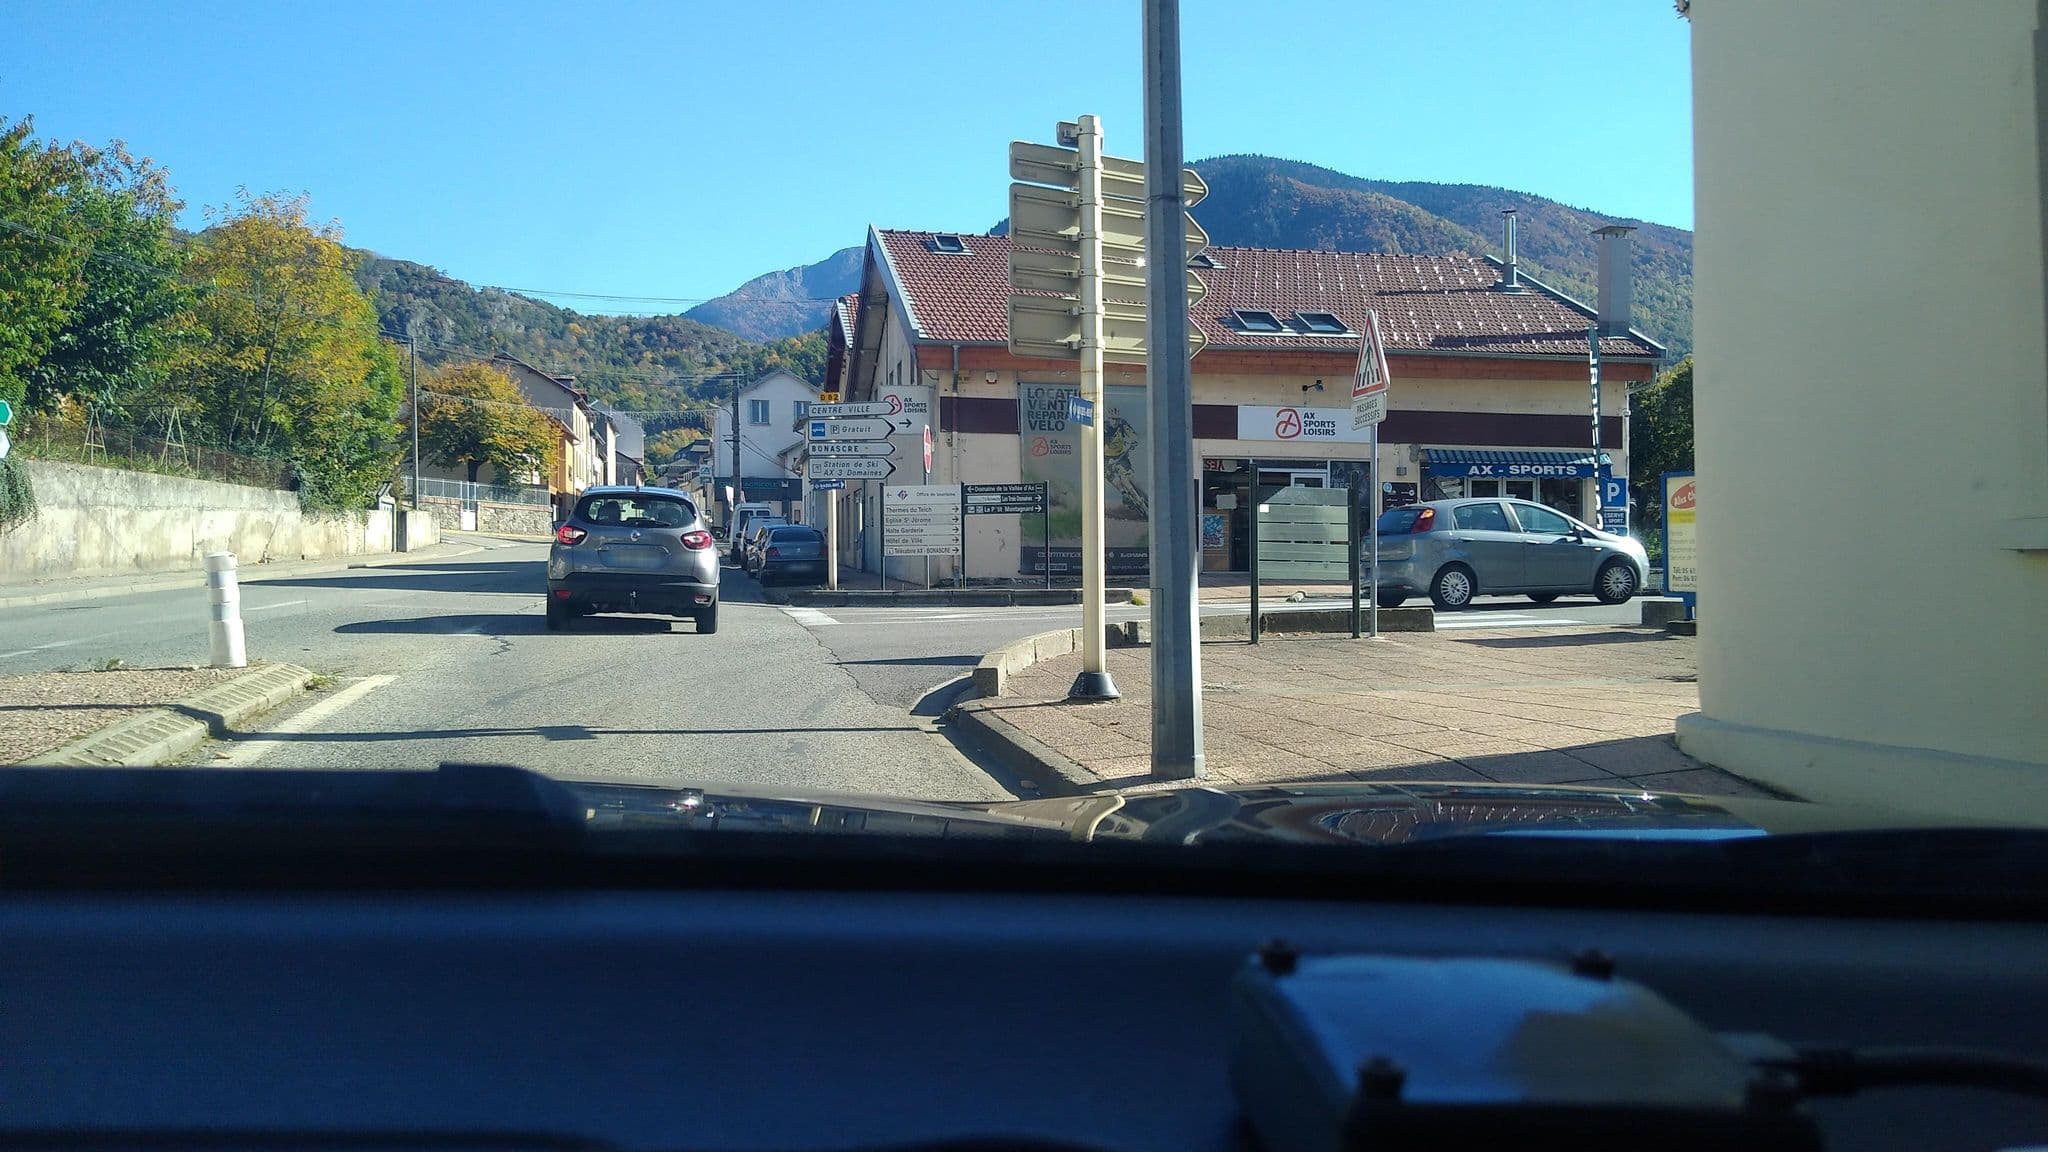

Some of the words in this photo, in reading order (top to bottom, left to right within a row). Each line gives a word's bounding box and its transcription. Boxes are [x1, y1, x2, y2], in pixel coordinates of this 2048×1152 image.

[1027, 387, 1081, 399] LOCATI
[811, 405, 842, 414] CENTRE
[848, 405, 871, 413] VILLE
[1027, 399, 1069, 411] VENT
[1356, 398, 1378, 412] PASSAGES
[1303, 412, 1315, 420] AX
[1354, 409, 1380, 426] SUCCESSIFS
[1027, 420, 1065, 432] VELO
[1303, 420, 1336, 428] SPORTS
[1303, 427, 1336, 436] LOISIRS
[1468, 465, 1493, 475] AX
[1509, 465, 1578, 475] SPORTS
[1607, 482, 1620, 502] P
